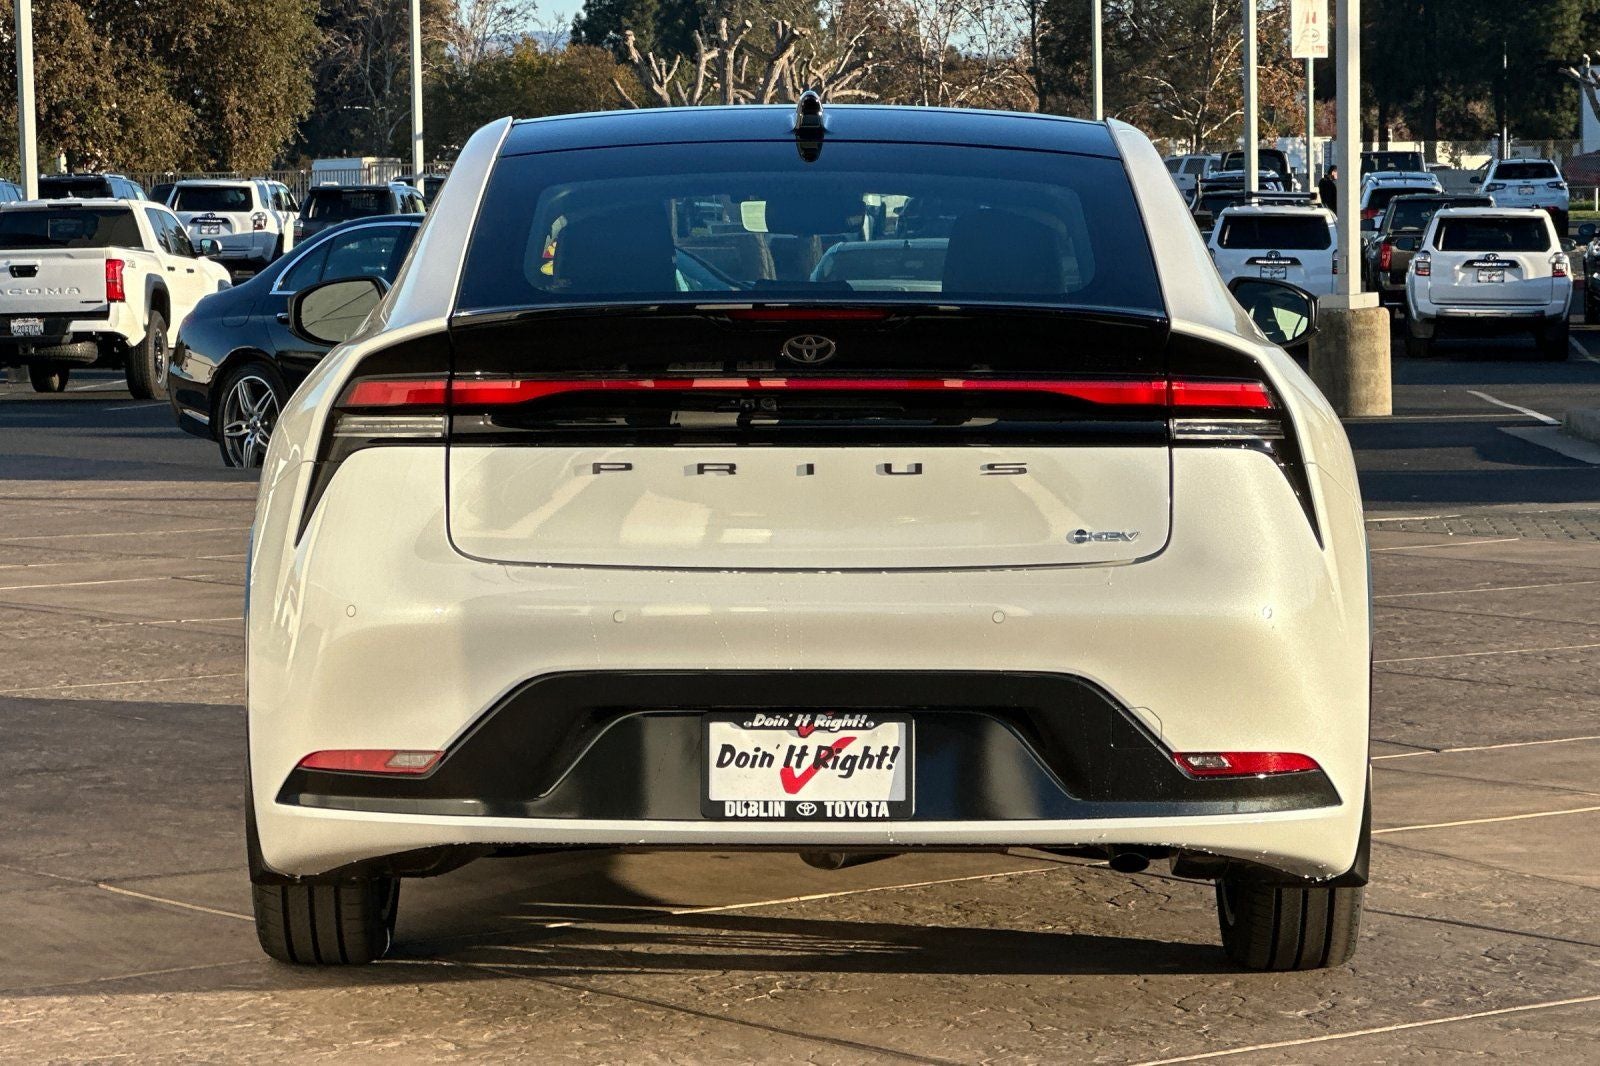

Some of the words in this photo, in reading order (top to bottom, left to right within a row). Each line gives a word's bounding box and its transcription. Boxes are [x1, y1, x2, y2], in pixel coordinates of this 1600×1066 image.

[0, 287, 81, 296] COMA
[593, 462, 1028, 475] PRIUS
[753, 714, 793, 727] Doin'
[795, 715, 814, 727] It
[814, 714, 868, 732] Right!
[716, 744, 781, 768] Doin'
[783, 745, 809, 769] It
[813, 745, 901, 778] Right!
[725, 801, 786, 817] DUBLIN
[824, 801, 890, 817] TOYOTA
